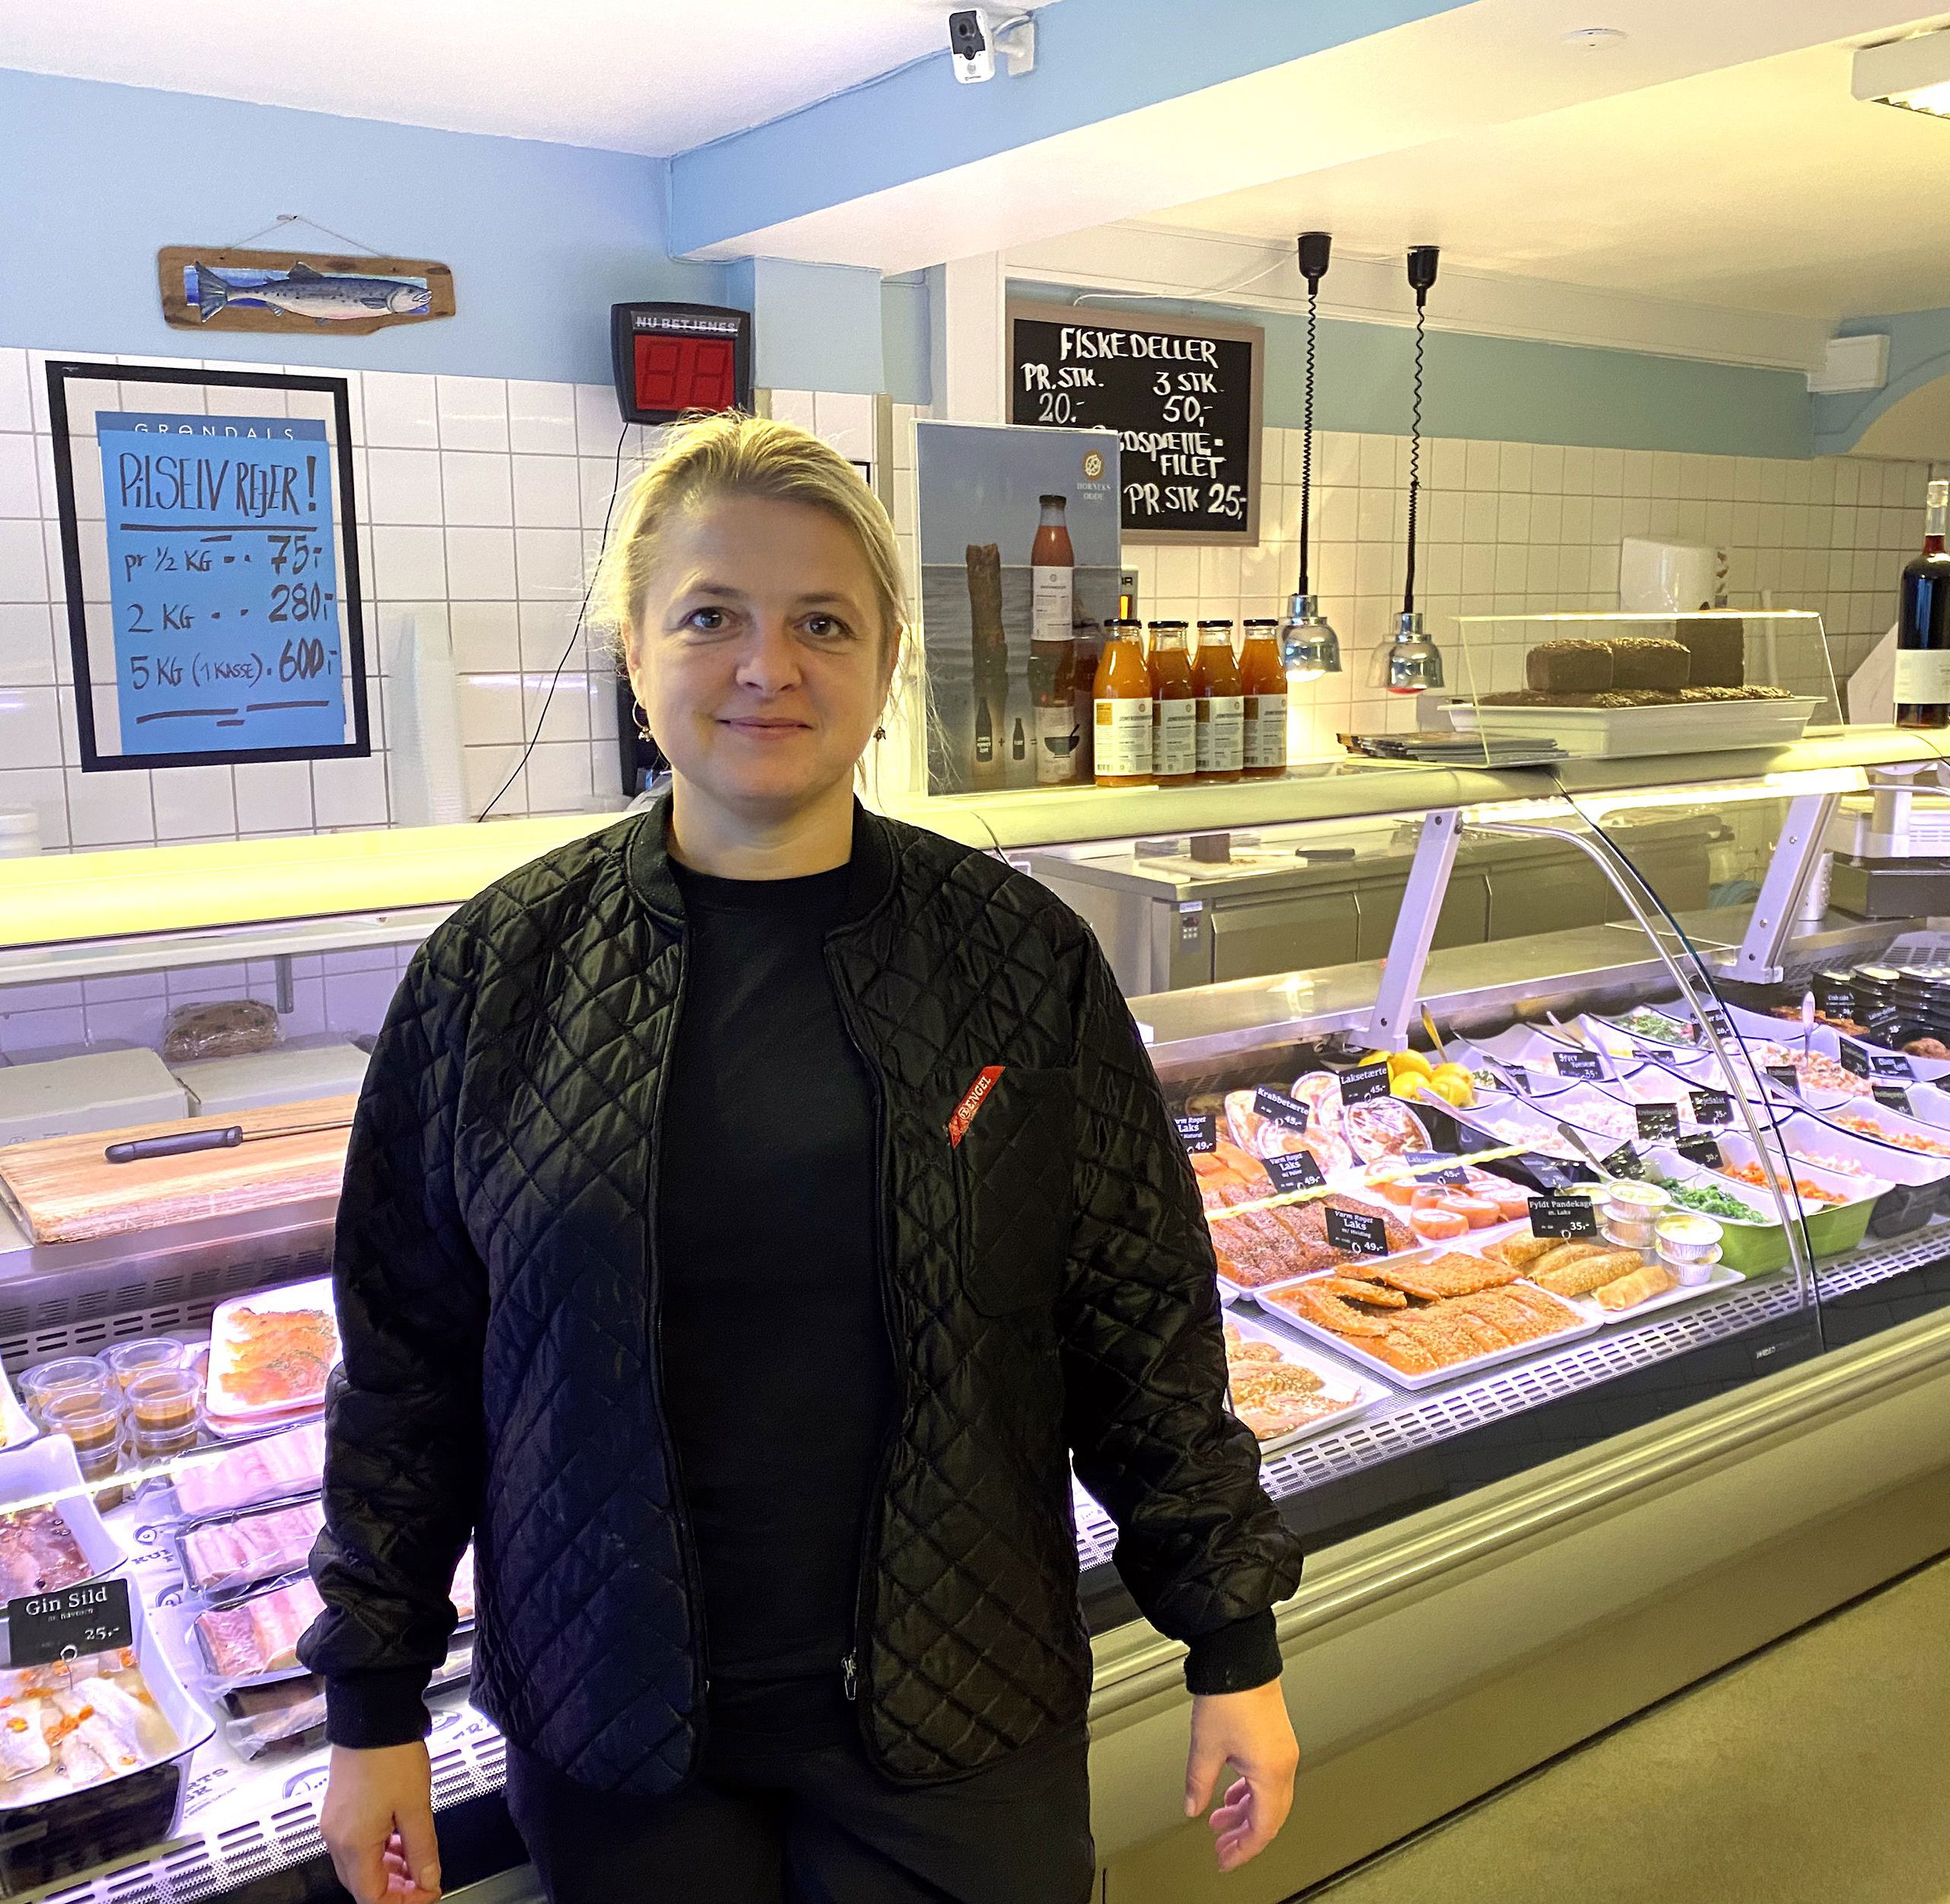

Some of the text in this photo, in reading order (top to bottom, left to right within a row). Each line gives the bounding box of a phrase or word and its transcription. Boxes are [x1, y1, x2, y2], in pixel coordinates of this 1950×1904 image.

[1152, 372, 1171, 395] 3
[1162, 395, 1213, 427] 50,-
[1160, 454, 1227, 479] FILET
[1207, 483, 1248, 520] 25,-
[184, 550, 213, 571] KG
[126, 603, 153, 633] 2
[162, 603, 195, 631] KG
[130, 655, 149, 690] 5
[157, 656, 184, 686] KG
[1341, 1067, 1387, 1085] Laksetærte
[964, 1075, 992, 1110] ENGEL
[1370, 1085, 1386, 1094] 45,-
[1258, 1087, 1309, 1116] Krabbetærte
[1177, 1123, 1200, 1133] Laks
[1194, 1141, 1213, 1151] 49,-
[1279, 1161, 1302, 1171] Laks
[1304, 1175, 1321, 1185] 49,-
[1529, 1200, 1550, 1210] Fyldt
[1335, 1210, 1354, 1220] Varm
[1344, 1219, 1367, 1231] Laks
[1570, 1222, 1590, 1232] 35,-
[1363, 1241, 1384, 1251] 49,-
[25, 1586, 108, 1616] Gin Sild
[85, 1627, 120, 1640] 25,-
